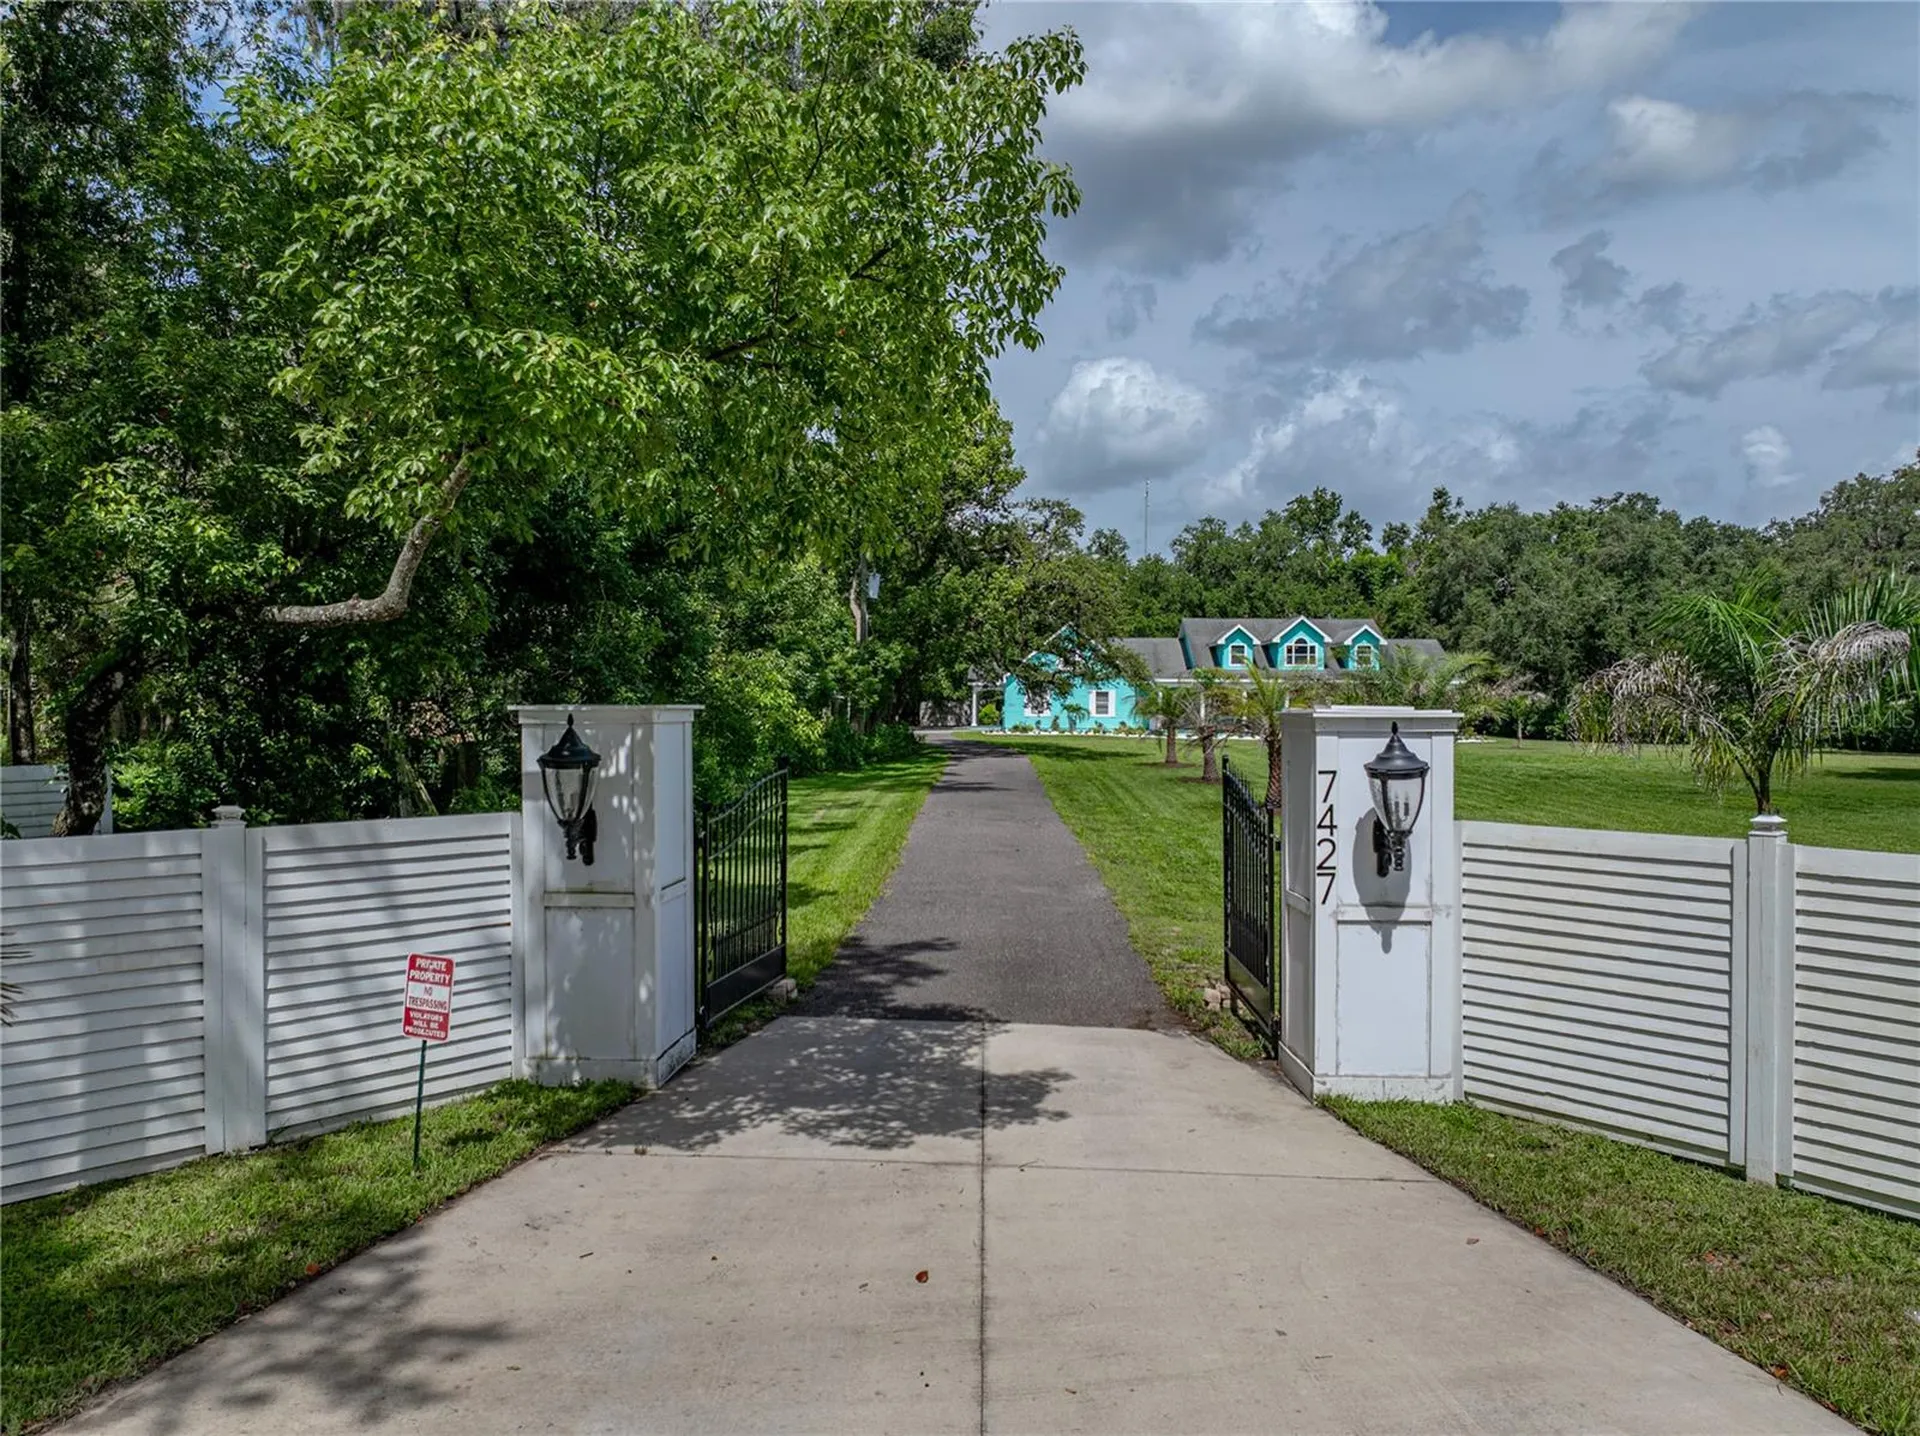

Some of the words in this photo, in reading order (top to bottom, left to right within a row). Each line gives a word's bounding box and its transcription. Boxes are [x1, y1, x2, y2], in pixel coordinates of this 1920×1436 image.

[1316, 770, 1338, 905] 7427
[415, 957, 447, 972] PRIVATE
[409, 969, 451, 984] PROPERTY
[423, 986, 433, 996] NO
[408, 995, 448, 1011] TRESPASSING
[409, 1010, 444, 1022] VIOLATORS
[412, 1019, 428, 1028] WILL
[429, 1021, 439, 1029] BE
[404, 1025, 446, 1038] PROSECUTED
